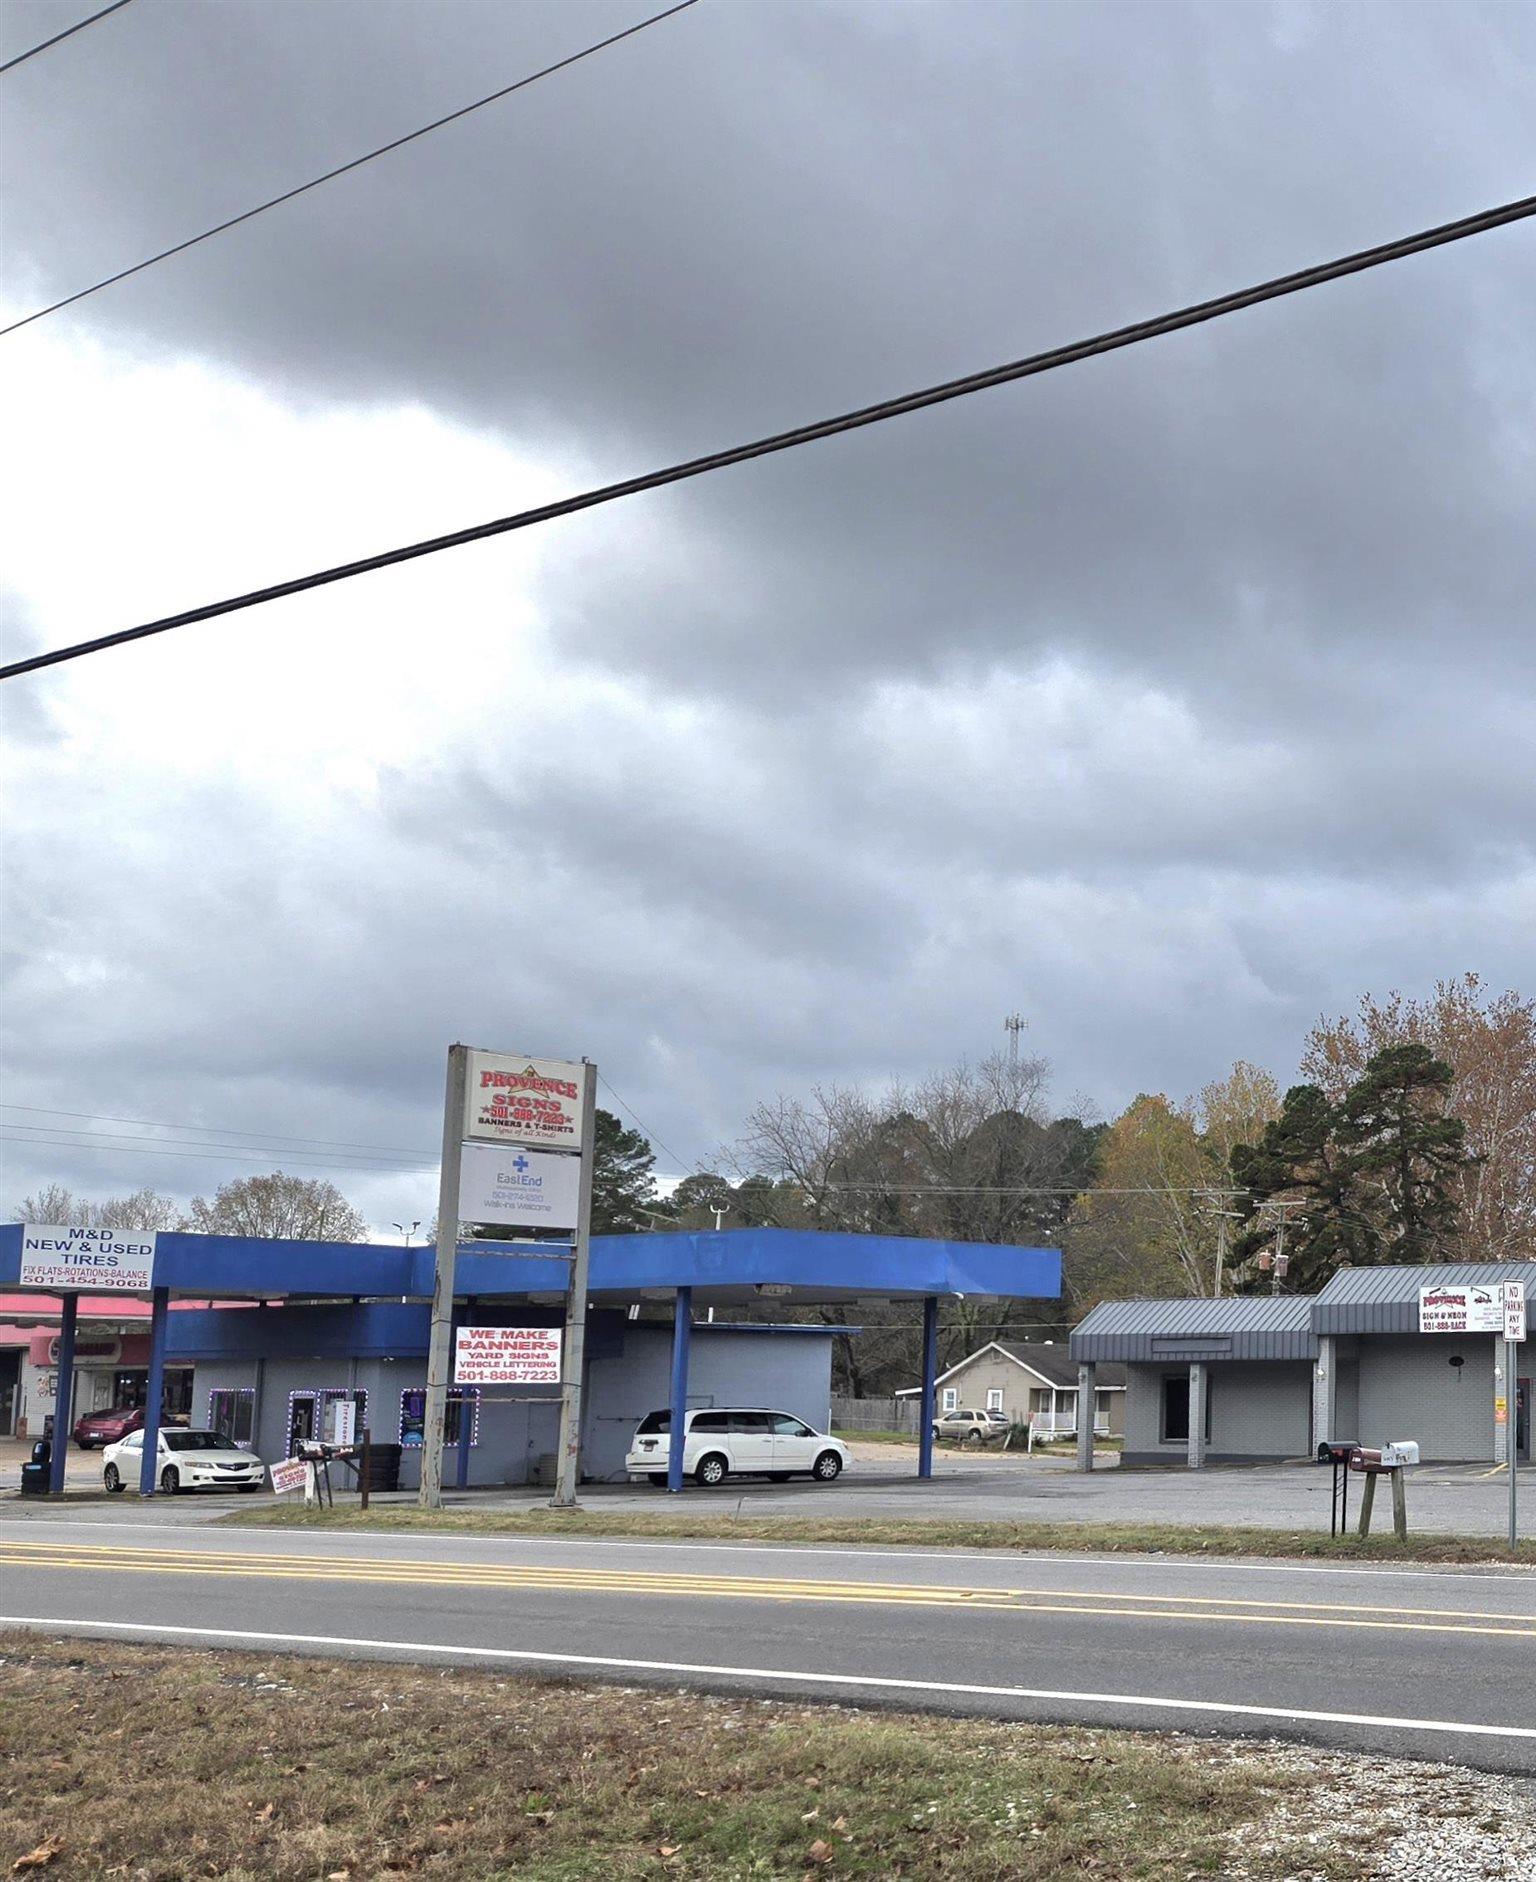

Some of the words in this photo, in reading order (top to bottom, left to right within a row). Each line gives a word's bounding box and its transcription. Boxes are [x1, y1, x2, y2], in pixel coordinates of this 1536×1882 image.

[480, 1070, 578, 1100] PROVENCE
[492, 1093, 562, 1112] SIGNS
[478, 1117, 522, 1128] BANNERS
[525, 1121, 531, 1129] &
[534, 1123, 574, 1133] T-SHIRTS
[69, 1228, 113, 1240] M&D
[26, 1239, 73, 1251] NEW
[79, 1241, 92, 1252] &
[100, 1243, 152, 1255] USED
[61, 1254, 119, 1267] TIRES
[23, 1265, 36, 1275] FIX
[23, 1275, 148, 1288] 501-454-9068
[1509, 1286, 1518, 1298] NO
[1505, 1300, 1524, 1312] PARKING
[1423, 1312, 1439, 1320] SIGN
[1447, 1311, 1467, 1320] NEON
[1509, 1315, 1519, 1323] ANY
[469, 1329, 495, 1339] WE
[501, 1330, 548, 1340] MAKE
[1509, 1326, 1520, 1335] TIME
[458, 1340, 558, 1351] BANNERS
[457, 1370, 557, 1380] 501-888-7223
